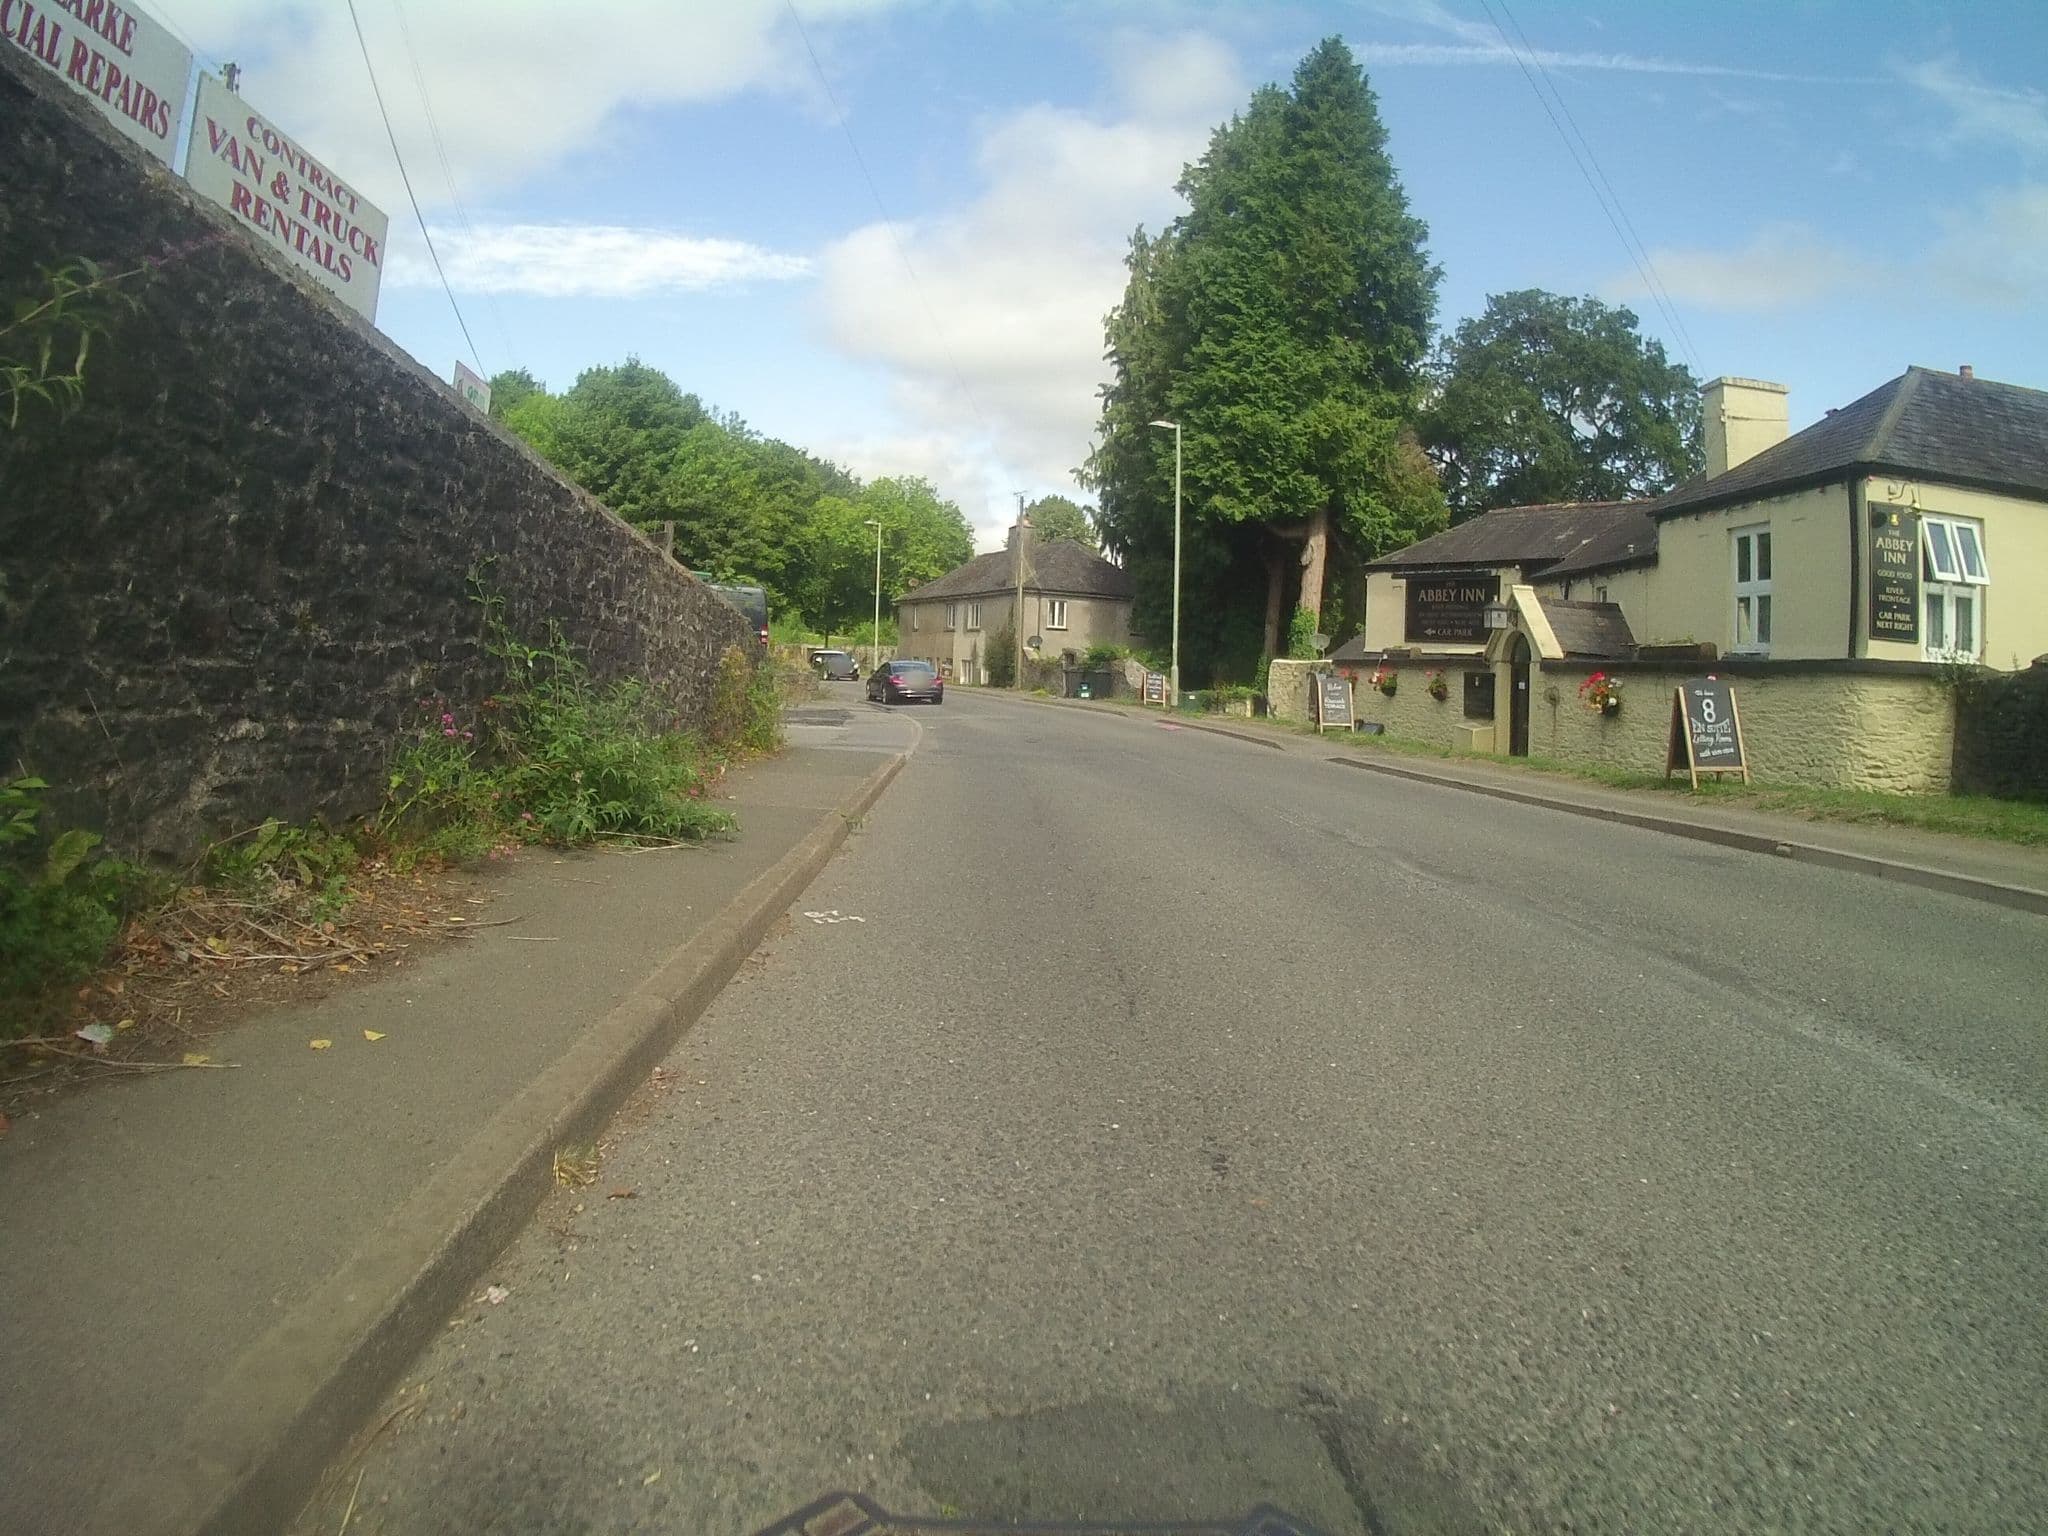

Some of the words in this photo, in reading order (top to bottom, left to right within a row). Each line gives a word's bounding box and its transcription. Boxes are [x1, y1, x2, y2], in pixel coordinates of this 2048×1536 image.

[53, 0, 138, 57] ARKE
[67, 36, 171, 140] REPAIRS
[246, 116, 359, 214] CONTRACT
[206, 116, 265, 186] VAN
[270, 171, 290, 205] &
[299, 184, 379, 267] TRUCK
[230, 179, 353, 283] RENTALS
[1888, 529, 1900, 537] THE
[1876, 536, 1914, 553] ABBEY
[1883, 551, 1907, 565] INN
[1877, 569, 1895, 578] GOOD
[1897, 571, 1912, 580] FOOD
[1418, 588, 1458, 602] ABBEY
[1460, 588, 1486, 602] INN
[1879, 611, 1893, 620] CAR
[1893, 613, 1911, 621] PARK
[1437, 629, 1452, 637] CAR
[1453, 629, 1473, 637] PARK
[1877, 620, 1893, 629] NEXT
[1894, 622, 1913, 631] RIGHT
[1702, 698, 1716, 723] 8
